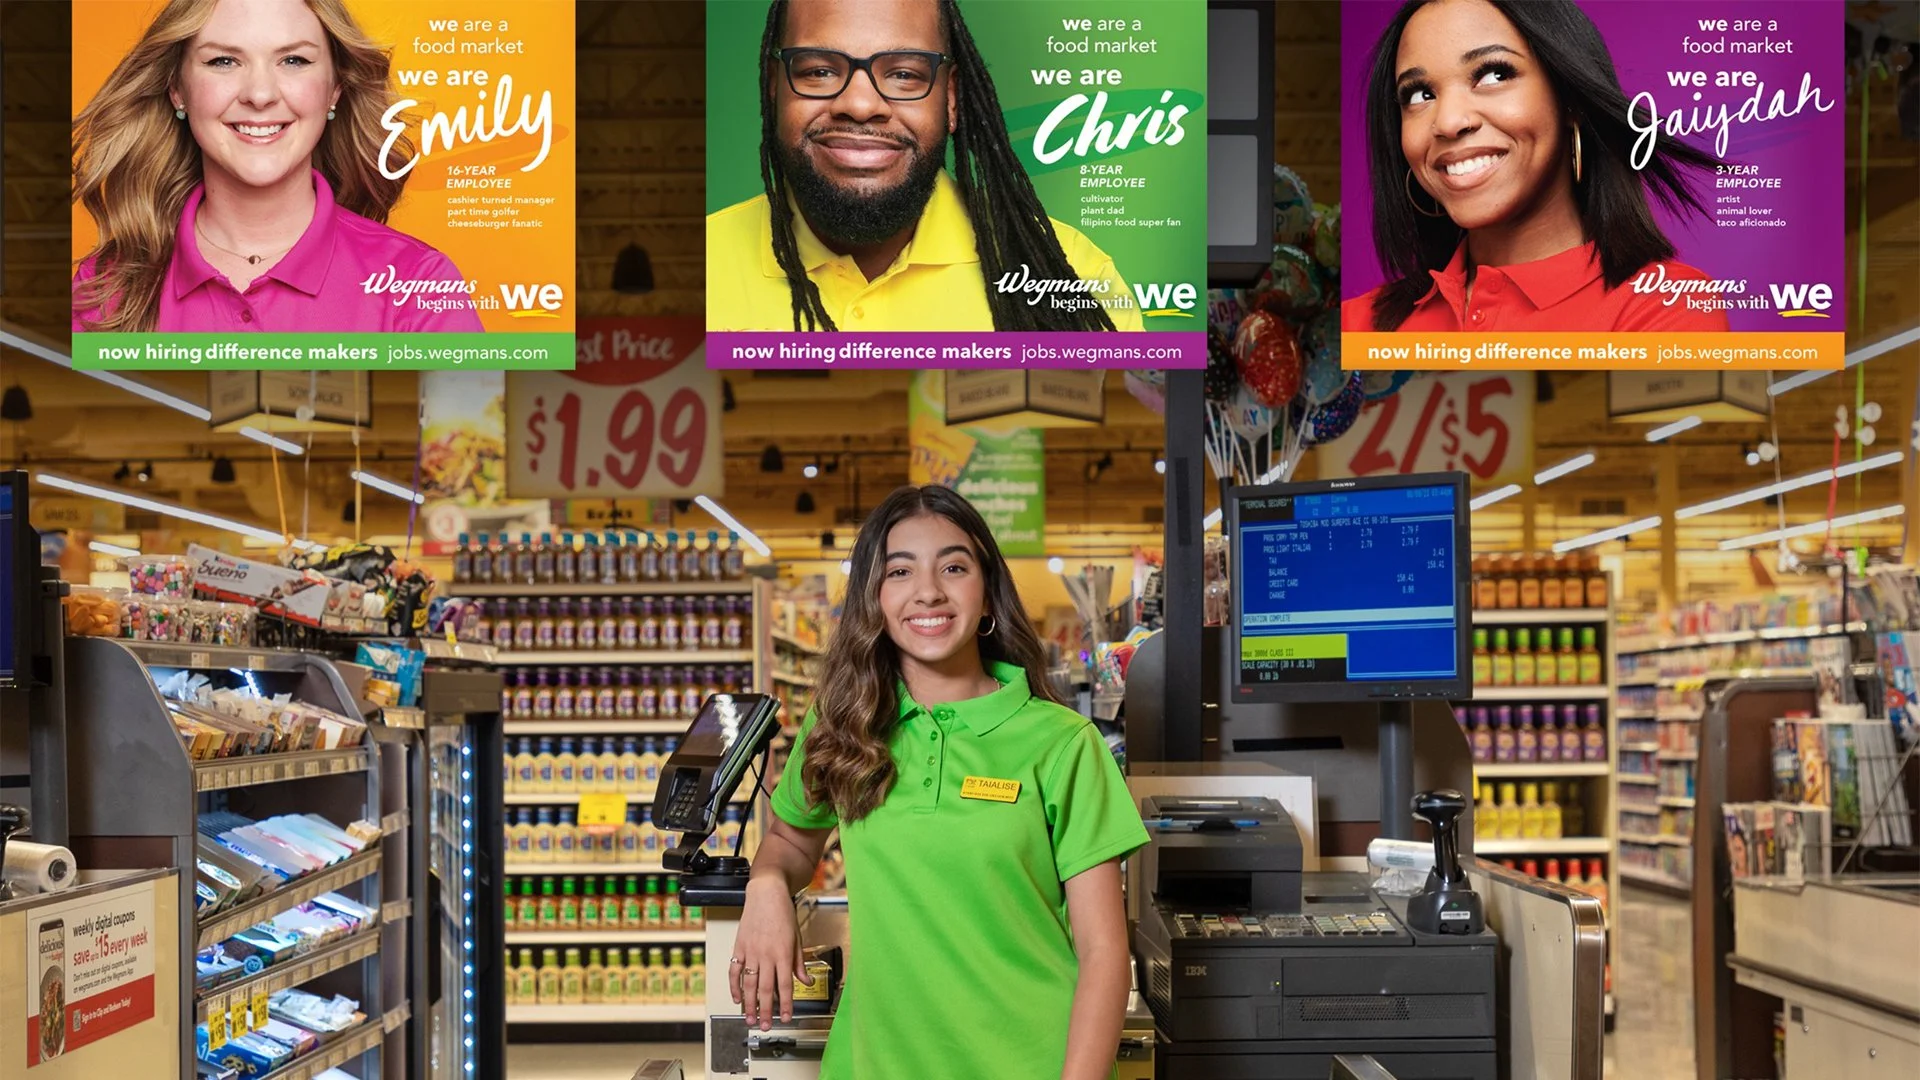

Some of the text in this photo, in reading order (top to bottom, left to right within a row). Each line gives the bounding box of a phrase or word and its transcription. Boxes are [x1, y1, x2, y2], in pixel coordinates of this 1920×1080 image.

[429, 19, 508, 31] we are a
[1062, 18, 1142, 31] we are a
[1698, 19, 1778, 31] we are a
[413, 37, 524, 54] food market
[1047, 36, 1157, 53] food market
[1682, 36, 1793, 53] food market
[398, 69, 489, 86] we are
[1031, 68, 1122, 85] we are
[1667, 70, 1757, 87] we are
[378, 74, 552, 180] Emily
[1033, 90, 1189, 165] Chris
[1627, 72, 1835, 171] Jaiydah
[447, 166, 496, 176] 16-YEAR
[1080, 165, 1123, 175] 8-YEAR
[1716, 165, 1759, 175] 3-YEAR
[446, 179, 512, 189] EMPLOYEE
[1080, 178, 1146, 188] EMPLOYEE
[1716, 178, 1781, 188] EMPLOYEE
[448, 196, 555, 206] cashier turned manager
[1081, 195, 1124, 203] cultivator
[1717, 195, 1740, 203] artist
[448, 208, 519, 218] part time golfer
[1081, 207, 1125, 216] plant dad
[1717, 207, 1772, 215] animal lover
[448, 220, 543, 230] cheeseburger fanatic
[1081, 218, 1181, 229] filipino food super fan
[1717, 218, 1786, 227] taco aficionado
[360, 264, 478, 306] Wegmans
[993, 263, 1111, 305] Wegmans
[1629, 264, 1747, 306] Wegmans
[417, 283, 563, 313] begins with we
[1051, 282, 1197, 312] begins with we
[1686, 283, 1833, 313] begins with we
[98, 343, 548, 364] now hiring difference makers jobs.wegmans.com
[612, 328, 675, 362] Price
[732, 343, 1182, 363] now hiring difference makers jobs.wegmans.com
[1368, 343, 1818, 364] now hiring difference makers jobs.wegmans.com
[1348, 376, 1513, 480] 2/$5
[526, 386, 707, 491] $1.99
[73, 911, 135, 937] weekly digital coupons
[73, 949, 90, 967] save
[110, 937, 129, 955] every
[130, 926, 148, 948] week
[1185, 965, 1207, 976] IBM
